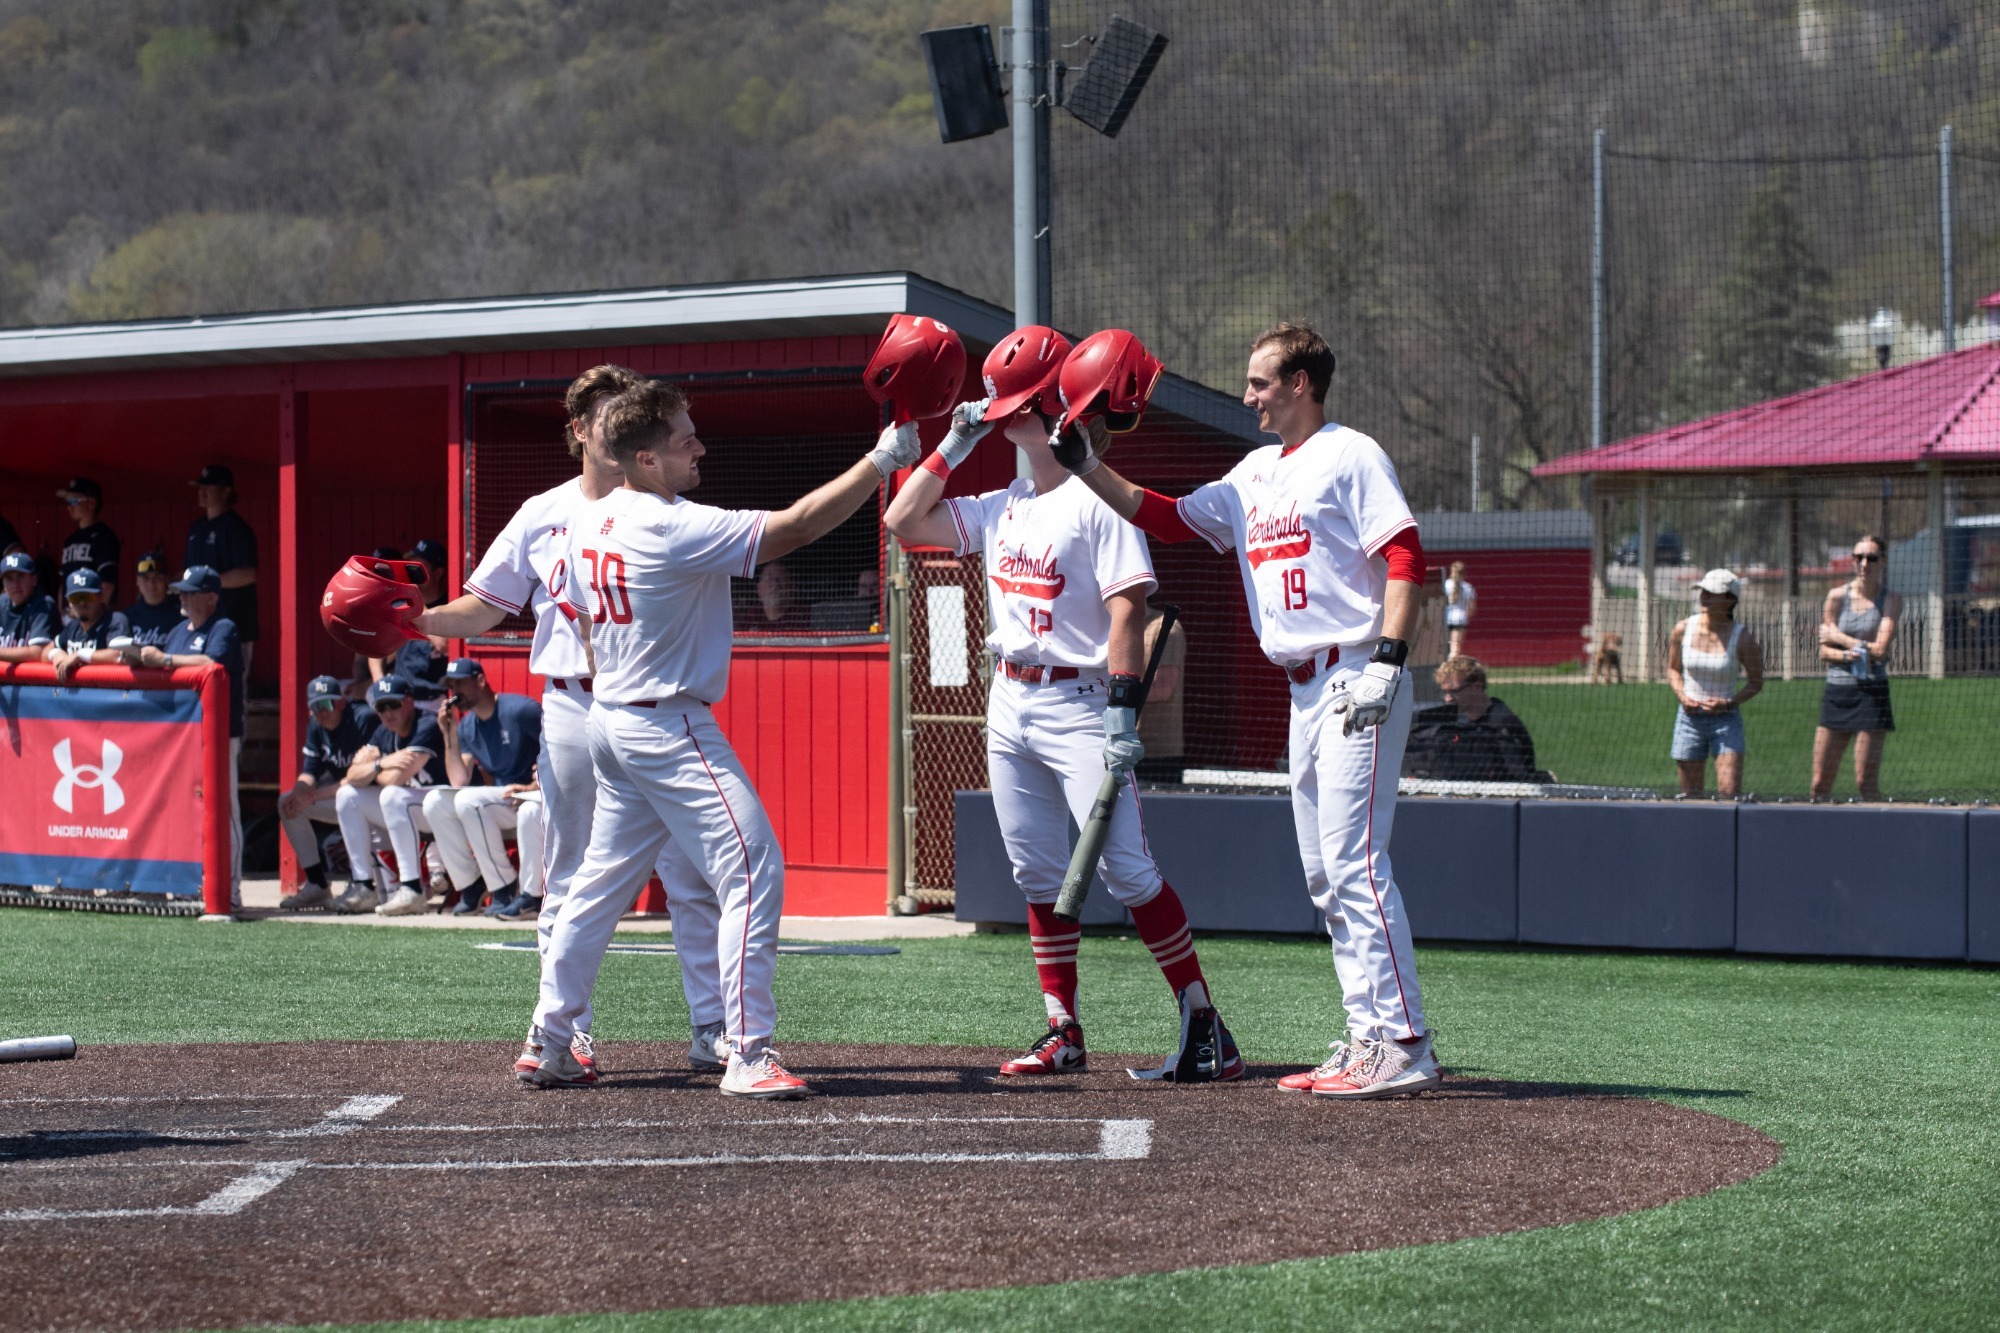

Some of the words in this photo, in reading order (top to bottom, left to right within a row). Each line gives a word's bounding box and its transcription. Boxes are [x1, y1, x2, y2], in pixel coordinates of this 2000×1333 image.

[1246, 500, 1302, 545] Cardinals
[581, 548, 633, 625] 30
[1281, 568, 1308, 611] 19
[48, 825, 83, 838] UNDER
[84, 826, 129, 840] ARMOUR
